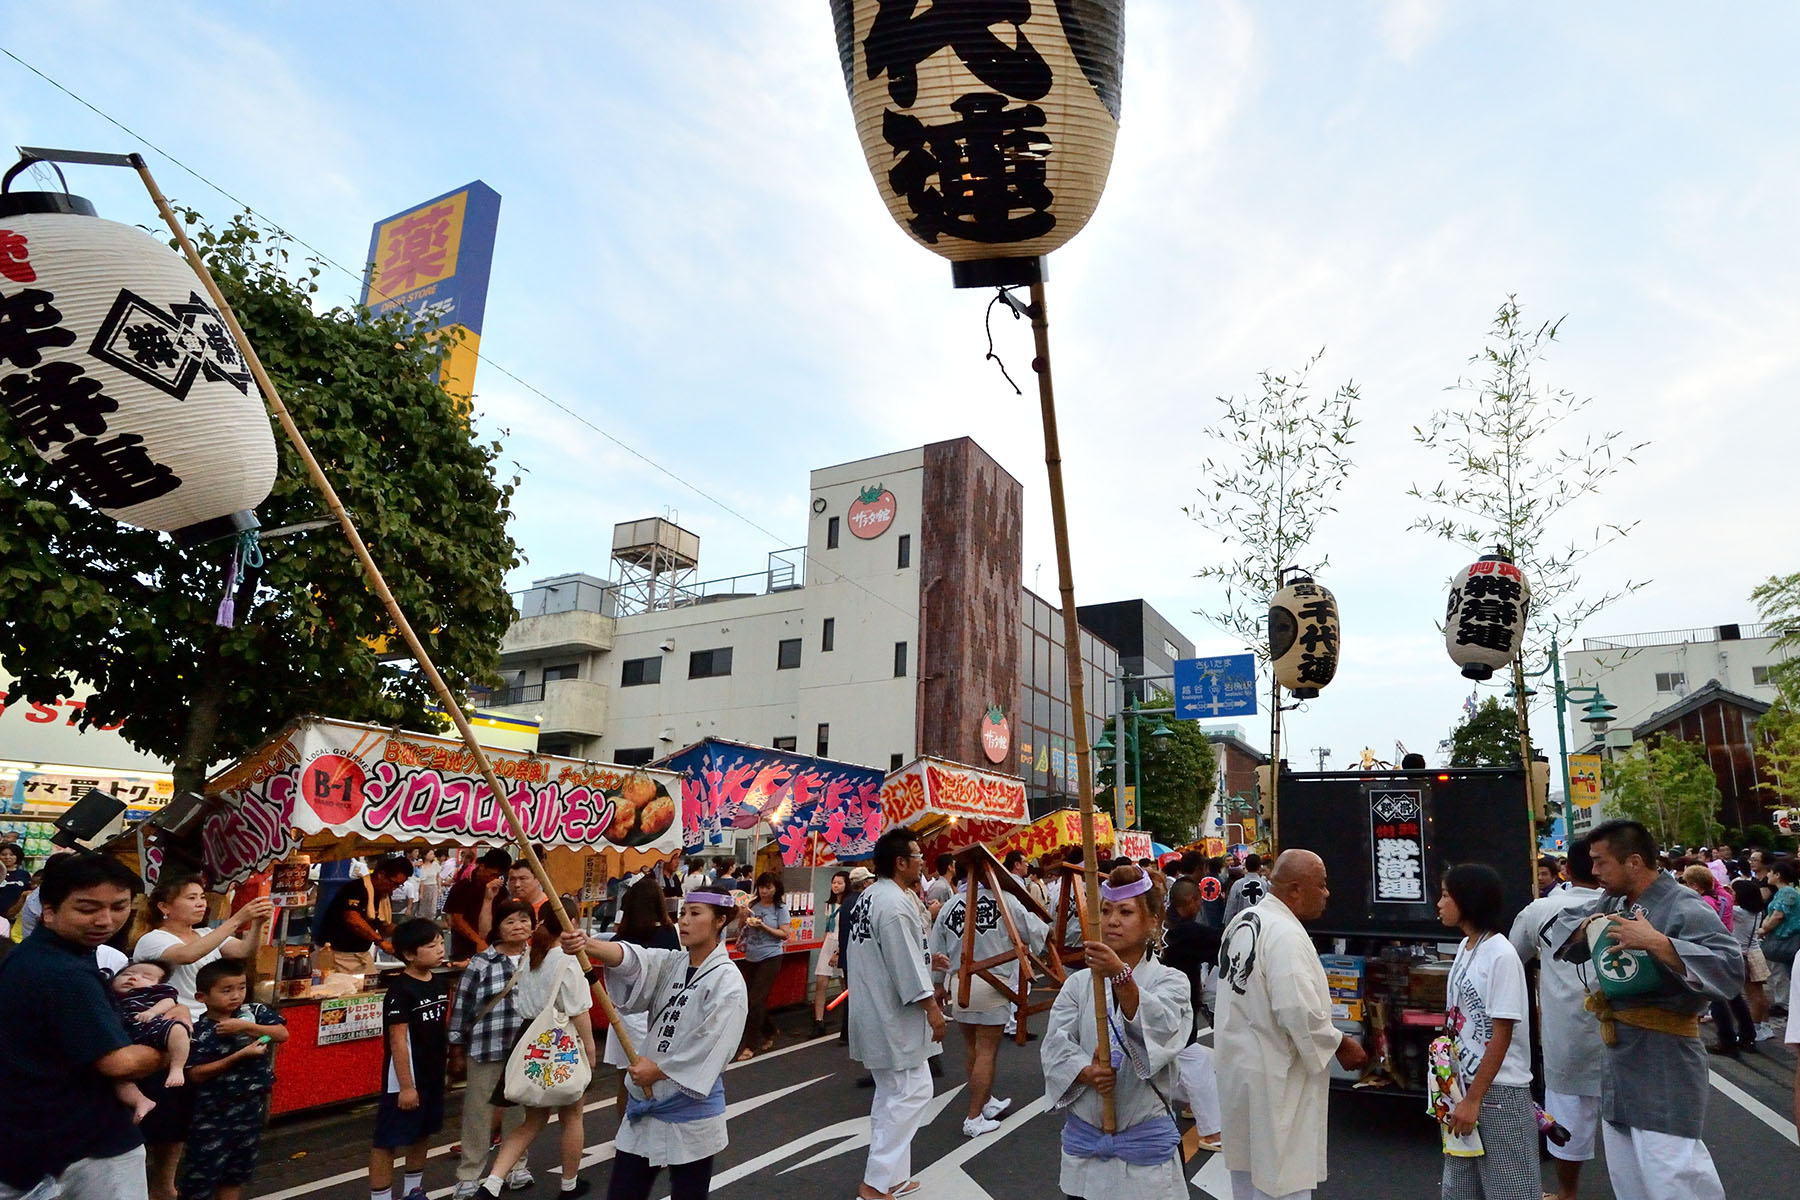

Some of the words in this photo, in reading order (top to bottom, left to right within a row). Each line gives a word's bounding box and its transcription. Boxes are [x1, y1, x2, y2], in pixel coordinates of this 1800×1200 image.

[379, 204, 455, 294] 薬
[407, 285, 438, 301] STORE
[852, 508, 892, 530] サラダ館
[983, 729, 1008, 750] サラダ館
[306, 747, 329, 763] LOCAL
[332, 747, 372, 774] GOURMET
[314, 768, 353, 802] B-1
[363, 759, 615, 844] シロコロホルモン
[348, 1003, 376, 1014] シロコロ
